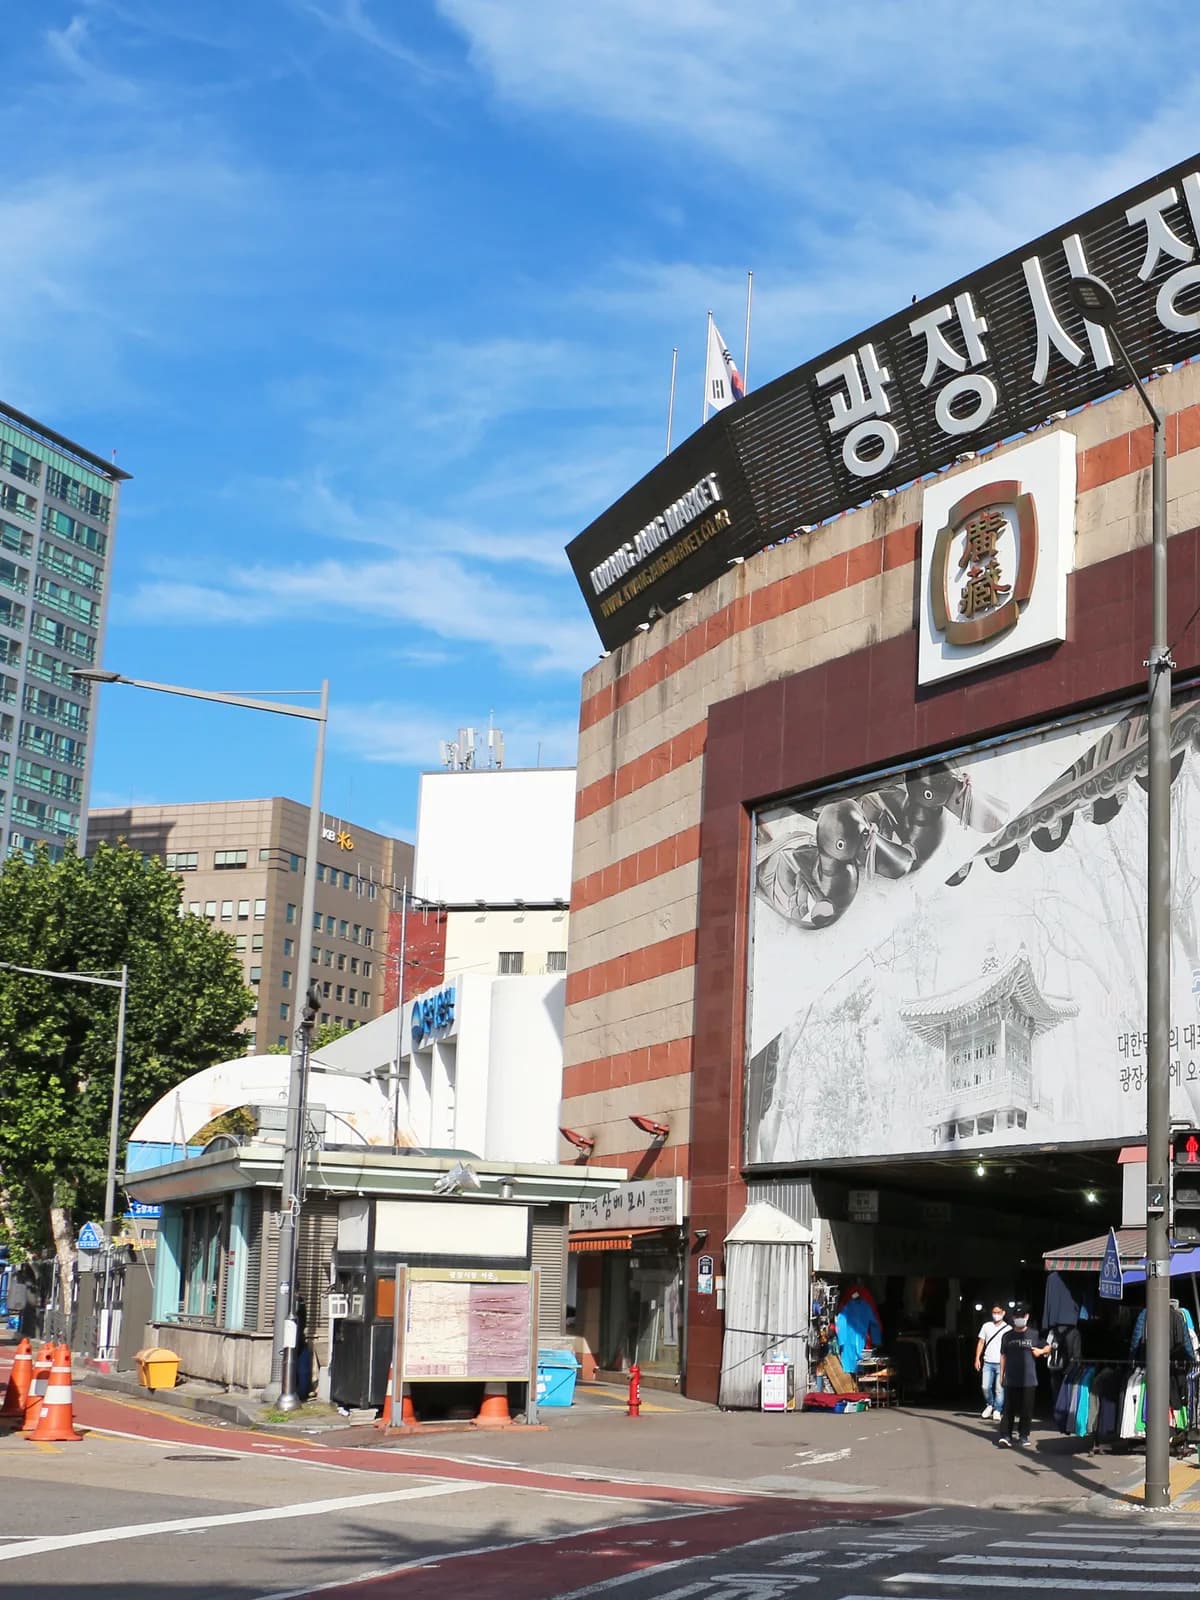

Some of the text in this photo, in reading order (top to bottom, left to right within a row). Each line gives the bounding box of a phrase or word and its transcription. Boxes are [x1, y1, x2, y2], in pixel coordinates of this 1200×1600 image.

[589, 472, 723, 595] KWANG JANG MARKET
